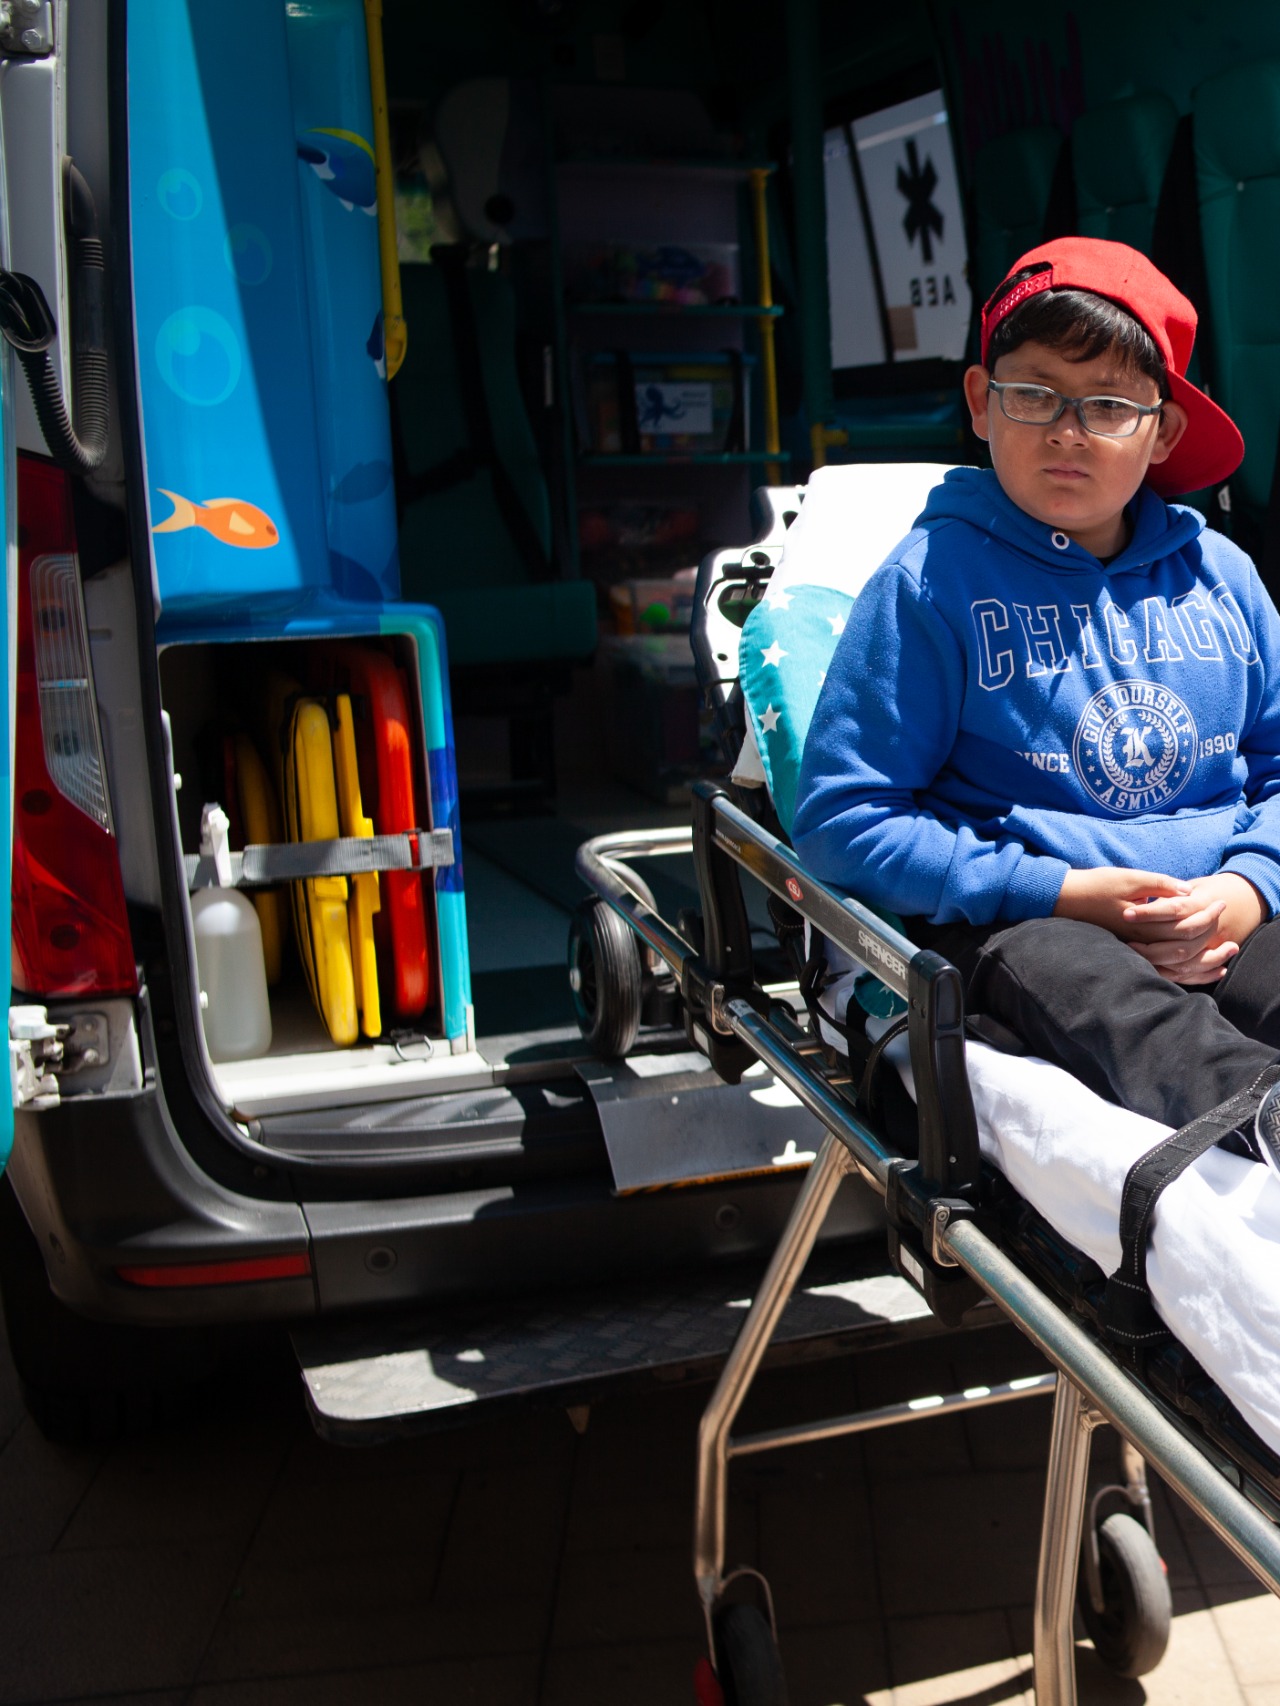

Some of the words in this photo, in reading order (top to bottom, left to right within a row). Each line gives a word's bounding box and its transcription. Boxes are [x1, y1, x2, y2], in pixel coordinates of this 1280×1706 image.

[970, 580, 1260, 692] CHICAGO
[1082, 698, 1113, 743] GIVE
[1109, 685, 1191, 734] YOURSELF
[1121, 725, 1156, 768] K
[1199, 731, 1235, 759] 1990
[1099, 785, 1116, 803] A
[1115, 779, 1173, 811] SMILE
[858, 930, 906, 980] SPENCER
